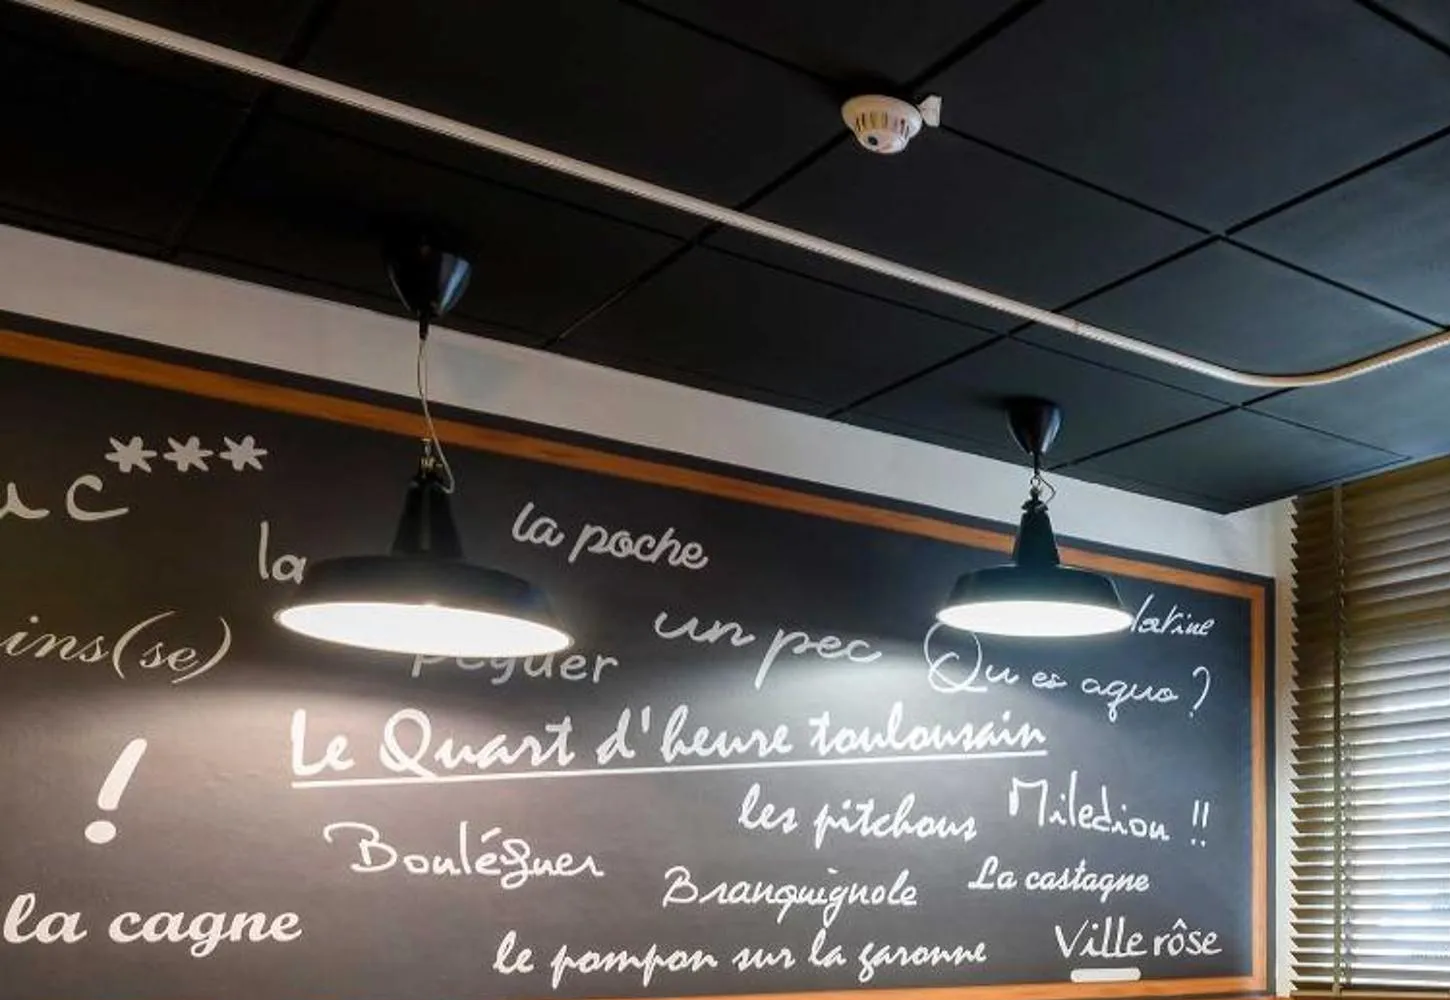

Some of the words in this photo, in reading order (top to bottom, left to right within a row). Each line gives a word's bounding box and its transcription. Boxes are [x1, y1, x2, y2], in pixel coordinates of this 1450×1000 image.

[258, 520, 307, 584] la
[512, 502, 564, 547] la
[568, 523, 709, 569] poche
[654, 611, 755, 647] un
[754, 628, 883, 690] pec
[290, 708, 356, 775] Le
[379, 708, 575, 781] Quart
[596, 704, 792, 765] d'heure
[808, 702, 1047, 757] toulousain
[737, 783, 798, 834] les
[813, 793, 977, 850] pitchous
[323, 821, 605, 889] Bouléguer
[968, 856, 1017, 892] La
[1025, 859, 1151, 902] castagne
[2, 892, 87, 944] la
[108, 908, 303, 958] cagne
[662, 866, 918, 928] Branquignole
[492, 929, 534, 974] le
[550, 942, 718, 989] pompon
[732, 944, 796, 972] sur
[807, 928, 847, 966] la
[856, 941, 987, 983] garonne
[1055, 916, 1147, 959] Ville
[1153, 917, 1223, 956] rôse
